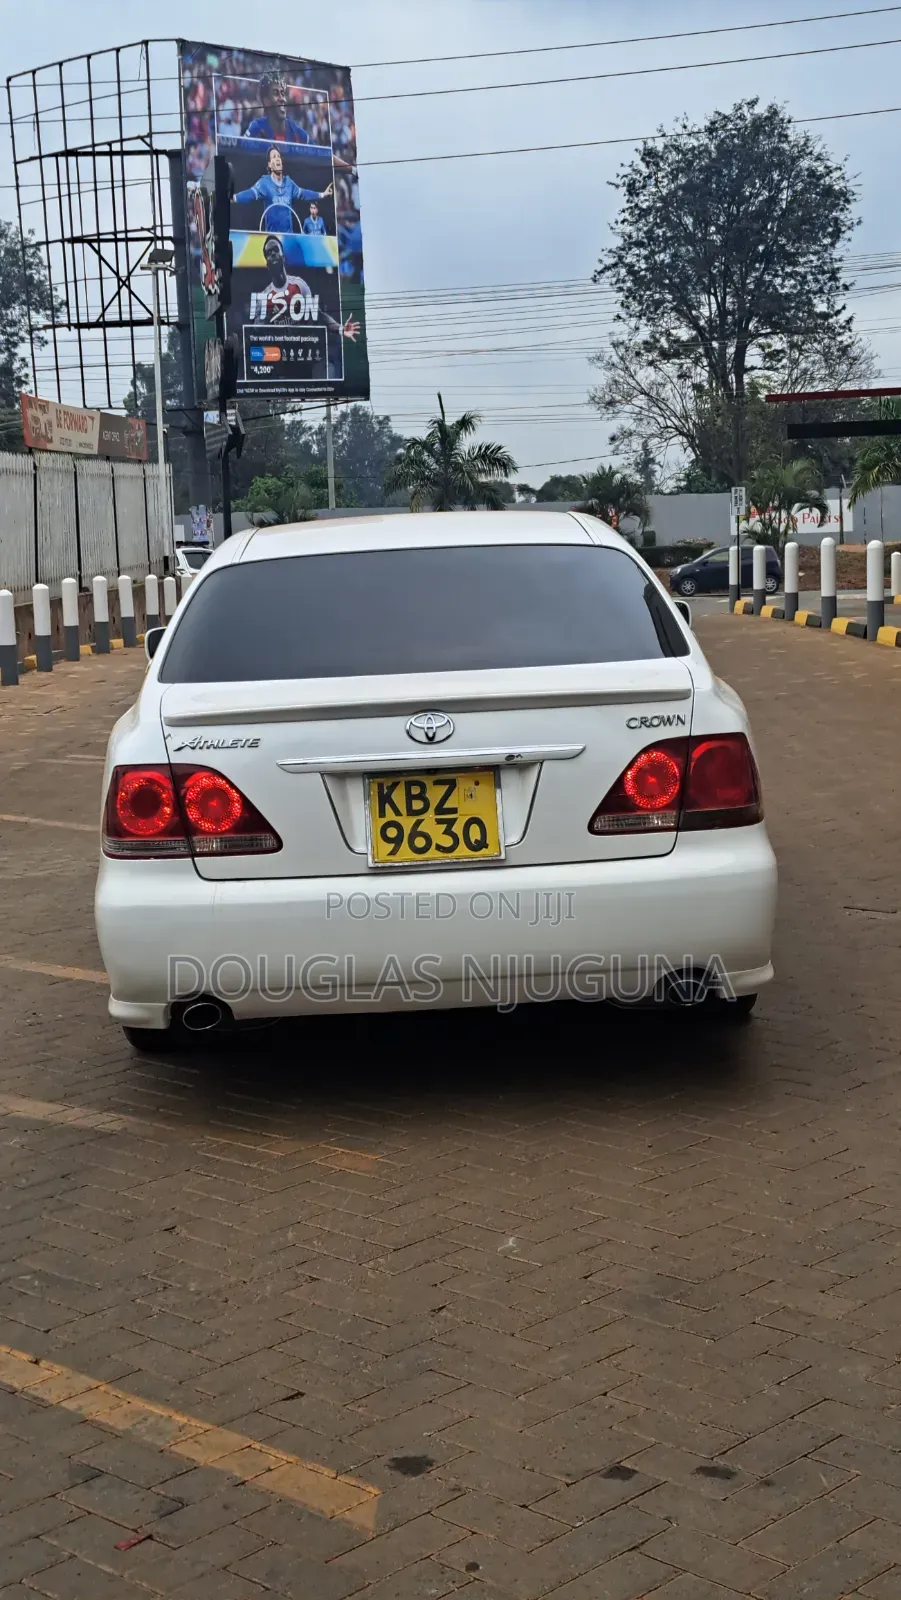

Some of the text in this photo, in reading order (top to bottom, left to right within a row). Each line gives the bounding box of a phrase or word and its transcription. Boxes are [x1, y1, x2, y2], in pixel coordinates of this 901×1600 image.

[290, 293, 319, 321] ON
[63, 410, 88, 434] FORWARD
[625, 714, 686, 729] CROWN
[173, 735, 260, 752] ATHLETE
[377, 778, 458, 818] KBZ
[380, 816, 489, 856] 963Q
